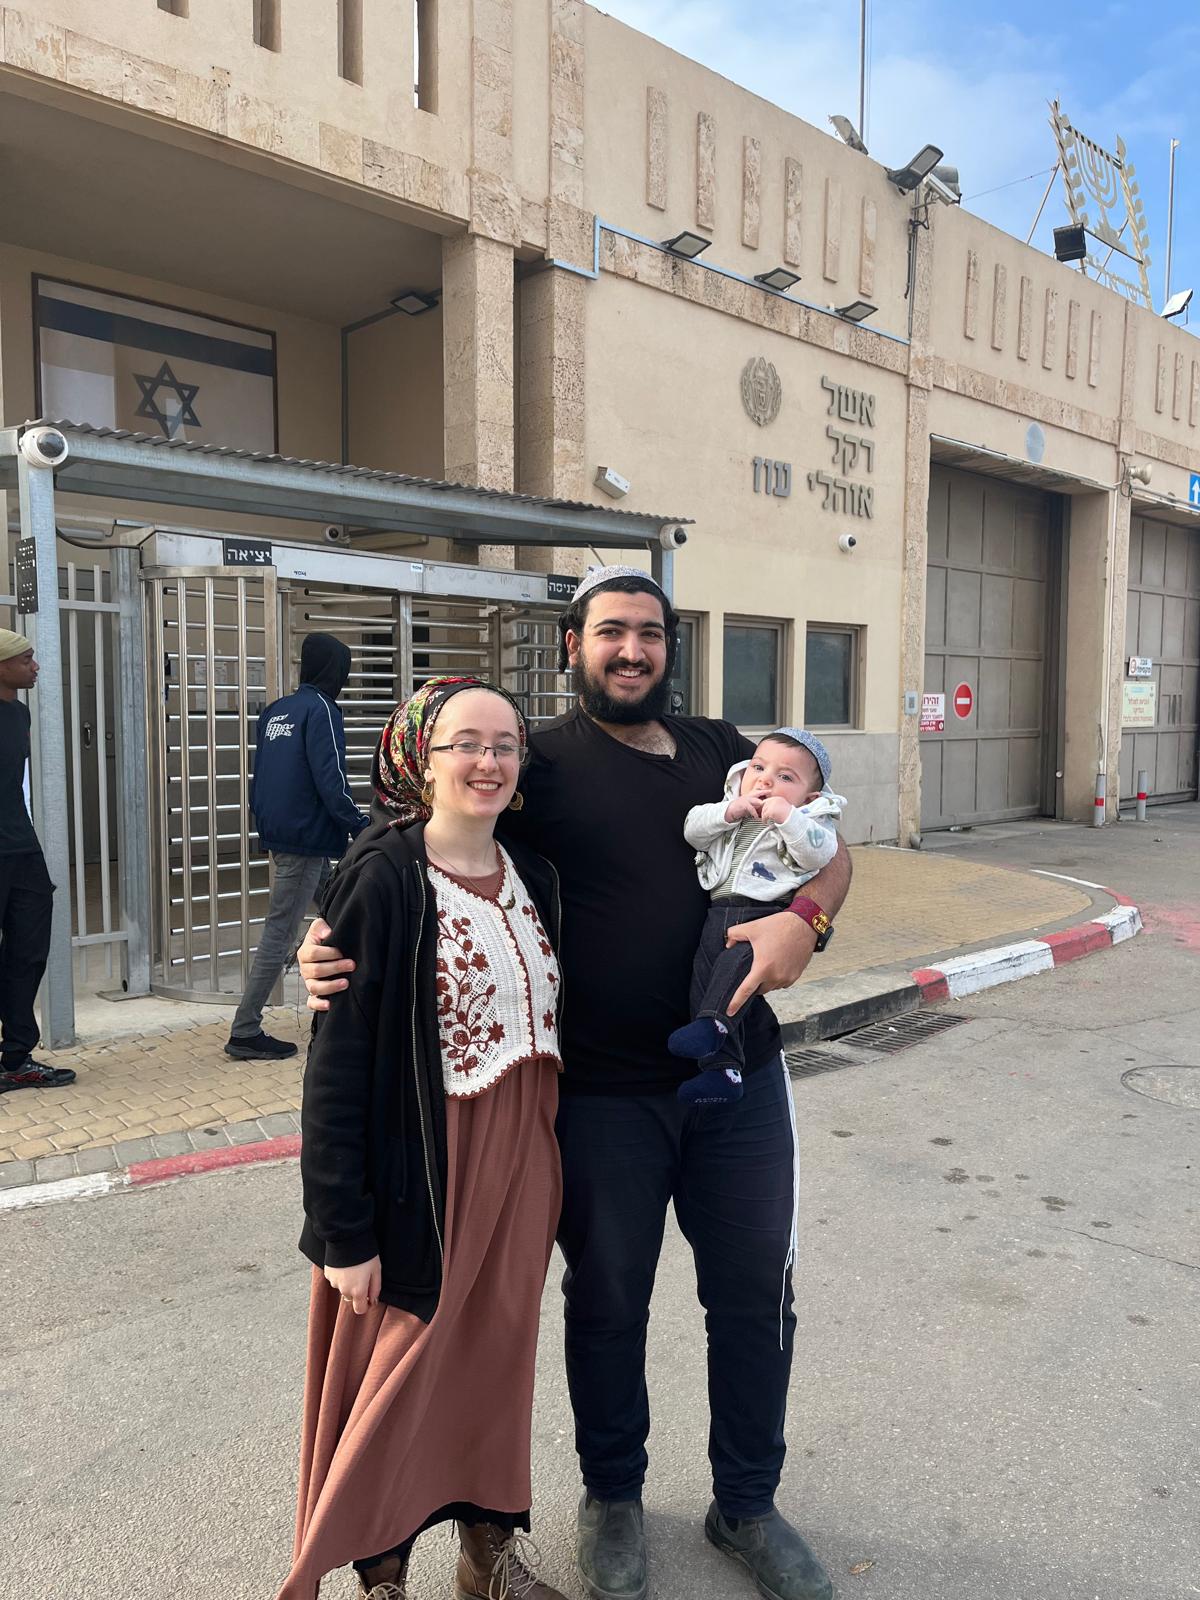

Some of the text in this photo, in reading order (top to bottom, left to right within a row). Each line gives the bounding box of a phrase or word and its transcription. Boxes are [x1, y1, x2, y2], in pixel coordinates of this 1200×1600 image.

[821, 375, 875, 427] אשל
[753, 456, 874, 519] אוהלי עוז
[227, 548, 271, 563] יציאה
[548, 582, 577, 594] כניסה
